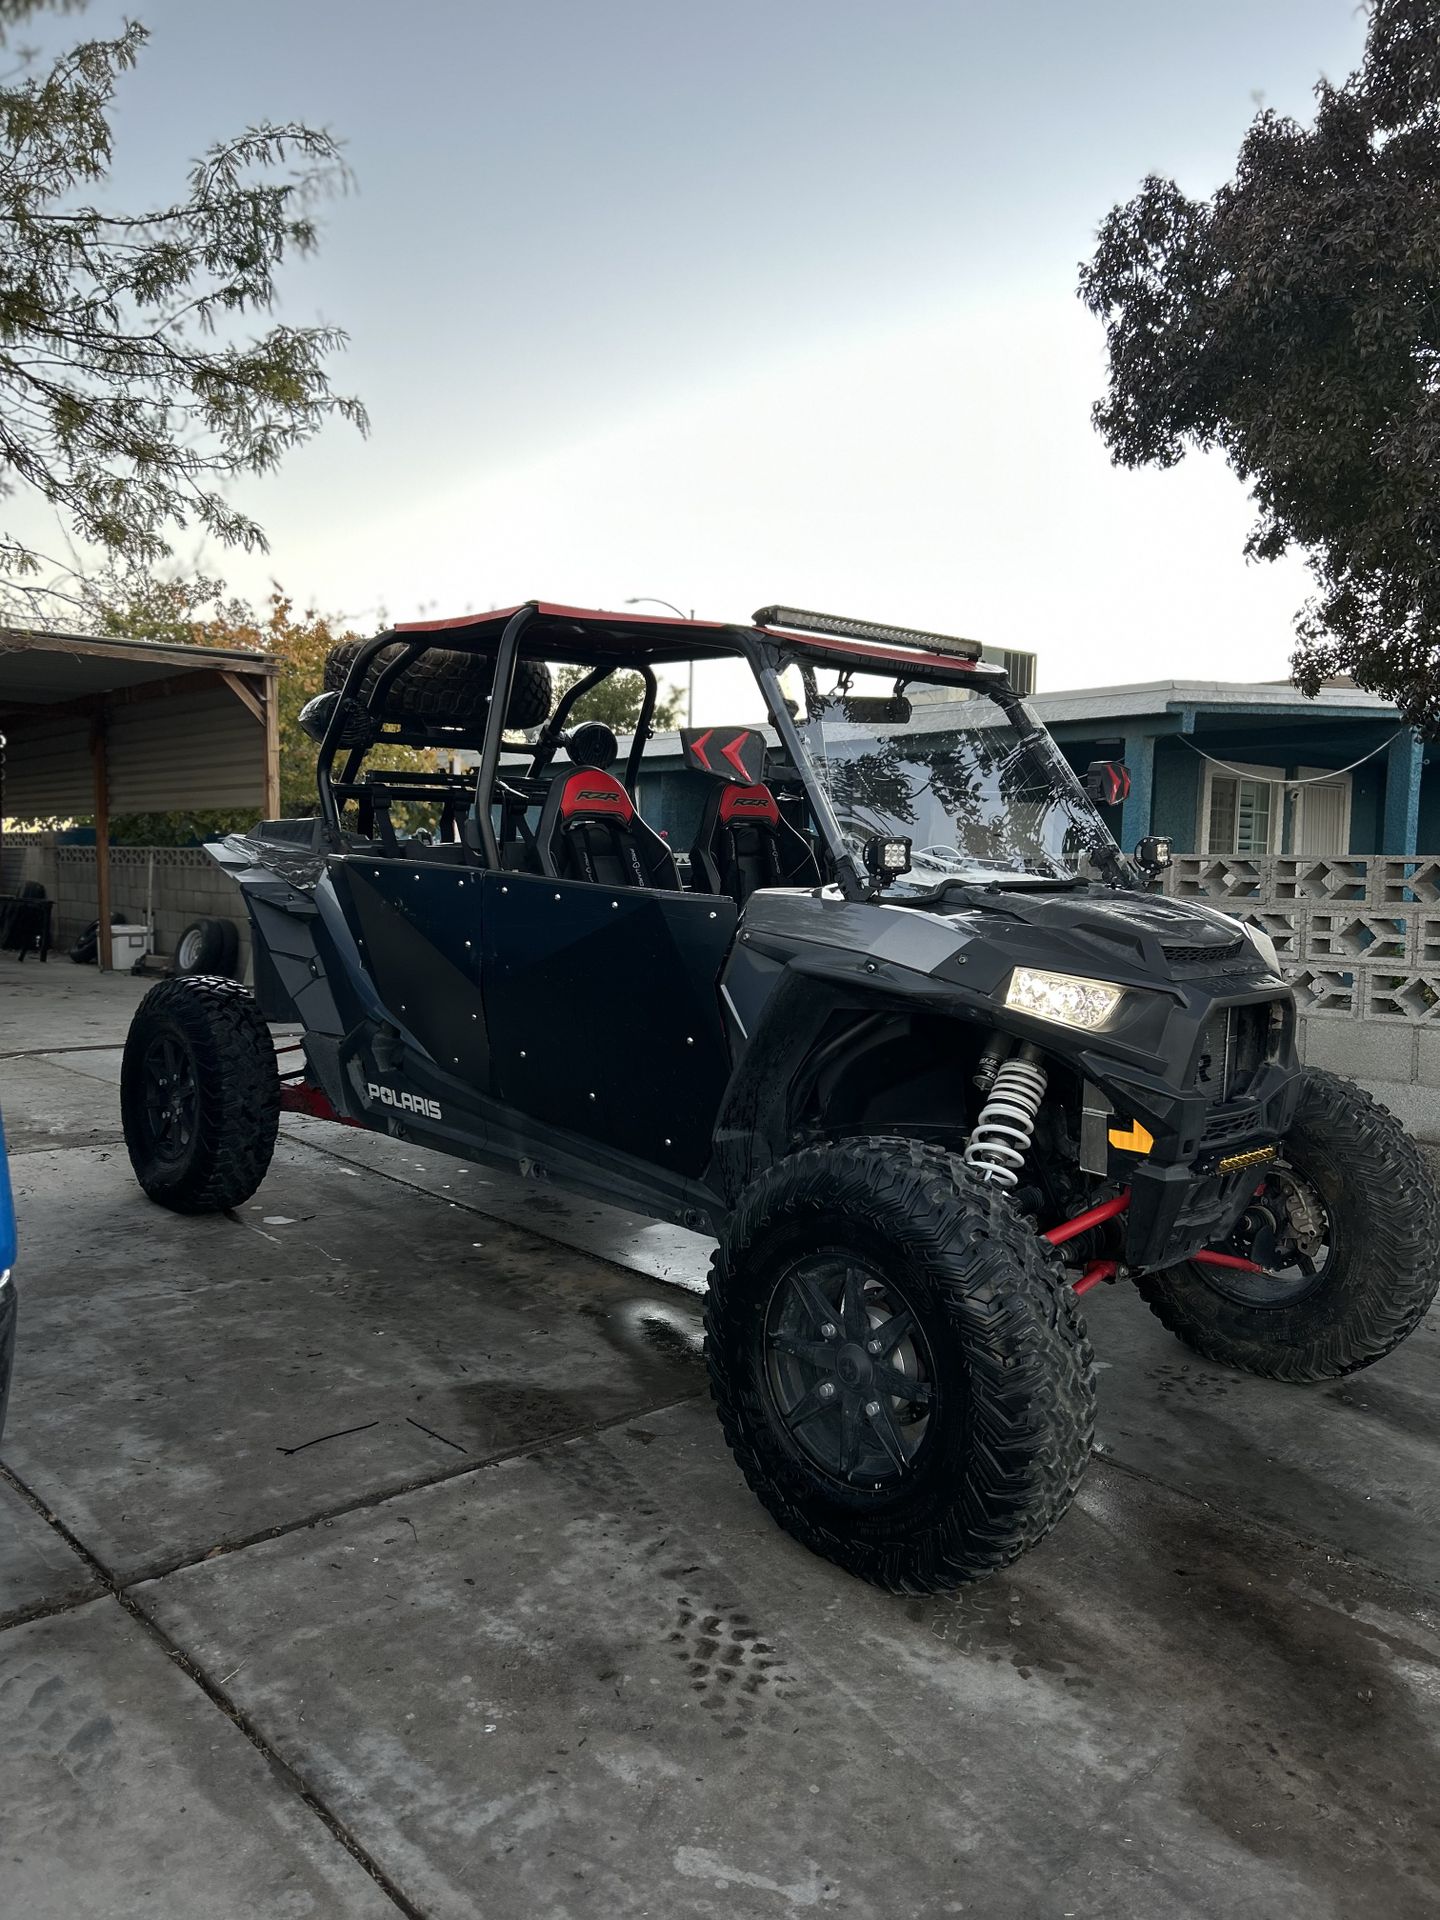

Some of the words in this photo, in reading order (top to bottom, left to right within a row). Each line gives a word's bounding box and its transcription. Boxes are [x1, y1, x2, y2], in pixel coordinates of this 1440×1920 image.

[576, 790, 620, 802] RZR
[733, 797, 769, 807] RZR
[367, 1082, 442, 1120] POLARIS
